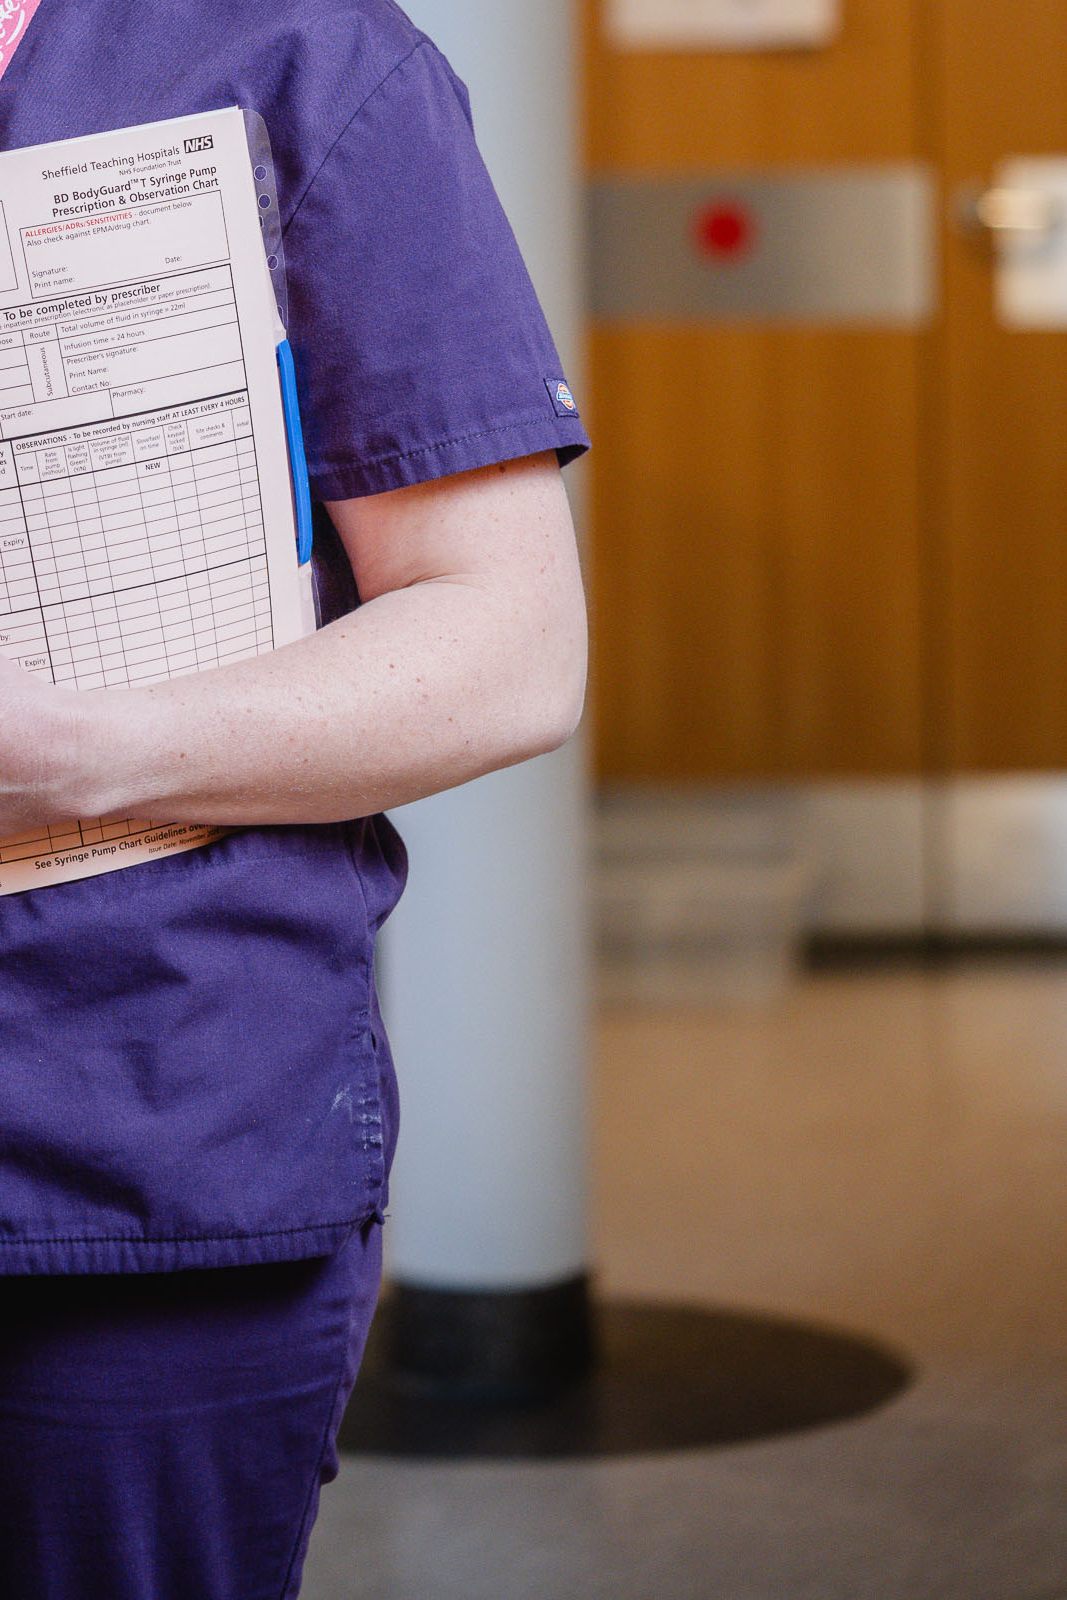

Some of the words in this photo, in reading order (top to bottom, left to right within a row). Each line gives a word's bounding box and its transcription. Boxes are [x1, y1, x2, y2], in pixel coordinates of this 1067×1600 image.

[183, 134, 214, 154] NHS
[41, 162, 87, 180] Sheffield
[89, 156, 134, 170] Teaching
[136, 145, 179, 162] Hospitals
[132, 162, 166, 173] Foundation
[53, 193, 69, 204] BD
[139, 177, 146, 187] T
[149, 172, 186, 186] Syringe
[189, 166, 216, 178] Pump
[52, 199, 115, 217] Prescription
[118, 195, 126, 205] &
[129, 184, 190, 202] Observation
[192, 177, 219, 190] Chart
[25, 211, 132, 237] ALLERGIES/ADRs/SENSITIVITIES
[138, 204, 171, 216] document
[172, 201, 192, 209] below
[26, 239, 42, 247] Also
[43, 234, 63, 243] check
[65, 230, 91, 240] against
[92, 222, 131, 234] EPMA/drug
[164, 255, 182, 264] Date:
[31, 266, 68, 278] Signature:
[34, 281, 51, 289] Print
[52, 276, 75, 286] name:
[2, 311, 16, 320] To
[18, 308, 32, 318] be
[36, 295, 91, 315] completed
[94, 294, 107, 304] by
[111, 284, 160, 302] prescriber
[60, 323, 78, 332] Total
[79, 320, 105, 329] volume
[106, 316, 113, 324] of
[115, 313, 131, 322] fluid
[140, 308, 163, 318] syringe
[29, 330, 50, 339] Route
[63, 340, 92, 350] Infusion
[126, 330, 145, 338] hours
[66, 353, 104, 365] Prescriber's
[39, 346, 53, 396] Subcutaneous
[69, 370, 86, 379] Print
[71, 382, 98, 393] Contact
[0, 412, 16, 420] Start
[15, 434, 67, 450] OBSERVATIONS
[92, 424, 120, 435] recorded
[131, 418, 155, 427] nursing
[156, 413, 170, 422] staff
[180, 406, 198, 416] LEAST
[200, 402, 218, 412] EVERY
[224, 395, 245, 406] HOURS
[145, 461, 160, 470] NEW
[3, 538, 24, 547] Expiry
[24, 658, 46, 667] Expiry
[34, 860, 51, 869] See
[54, 852, 89, 866] Syringe
[91, 845, 116, 857] Pump
[118, 838, 142, 850] Chart
[144, 827, 187, 843] Guidelines
